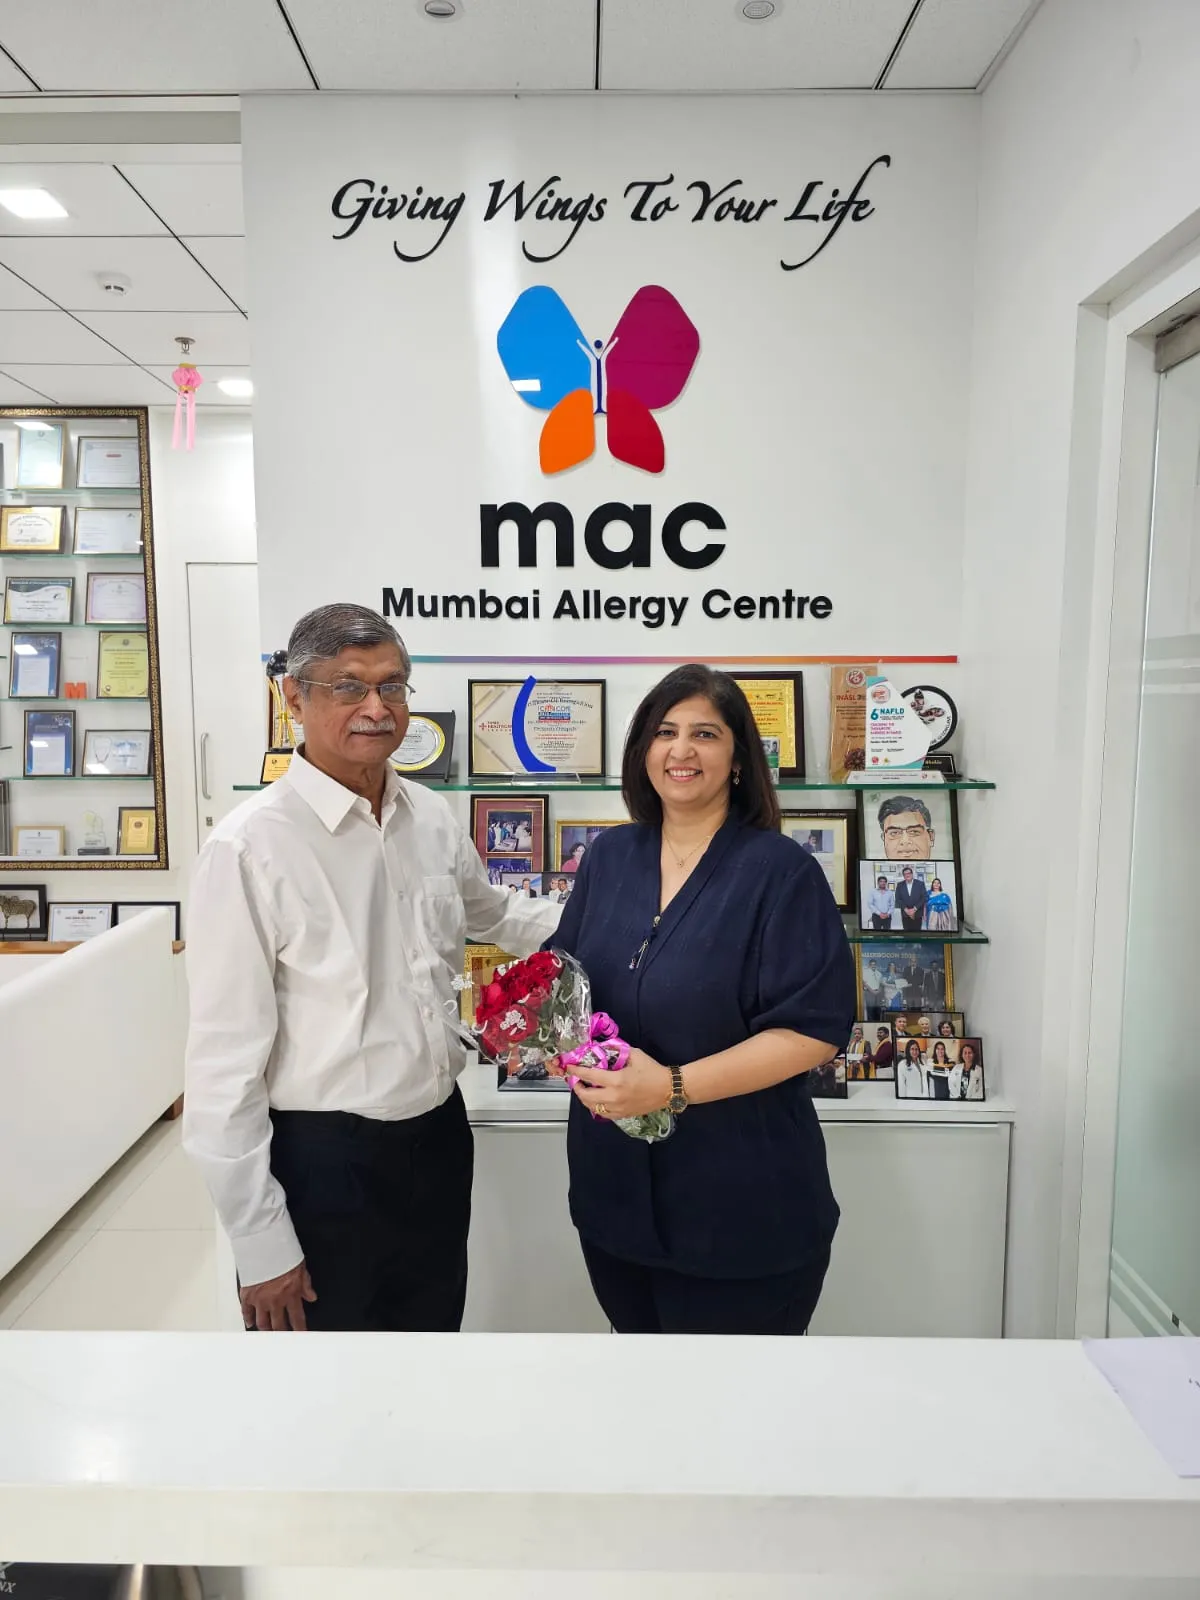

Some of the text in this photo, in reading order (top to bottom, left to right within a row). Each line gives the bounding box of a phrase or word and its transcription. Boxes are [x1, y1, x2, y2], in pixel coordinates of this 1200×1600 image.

[331, 154, 892, 272] Giving Wings To Your Life
[479, 501, 727, 570] mac
[382, 587, 833, 629] Mumbai Allergy Centre
[64, 682, 87, 699] M
[870, 708, 879, 721] 6
